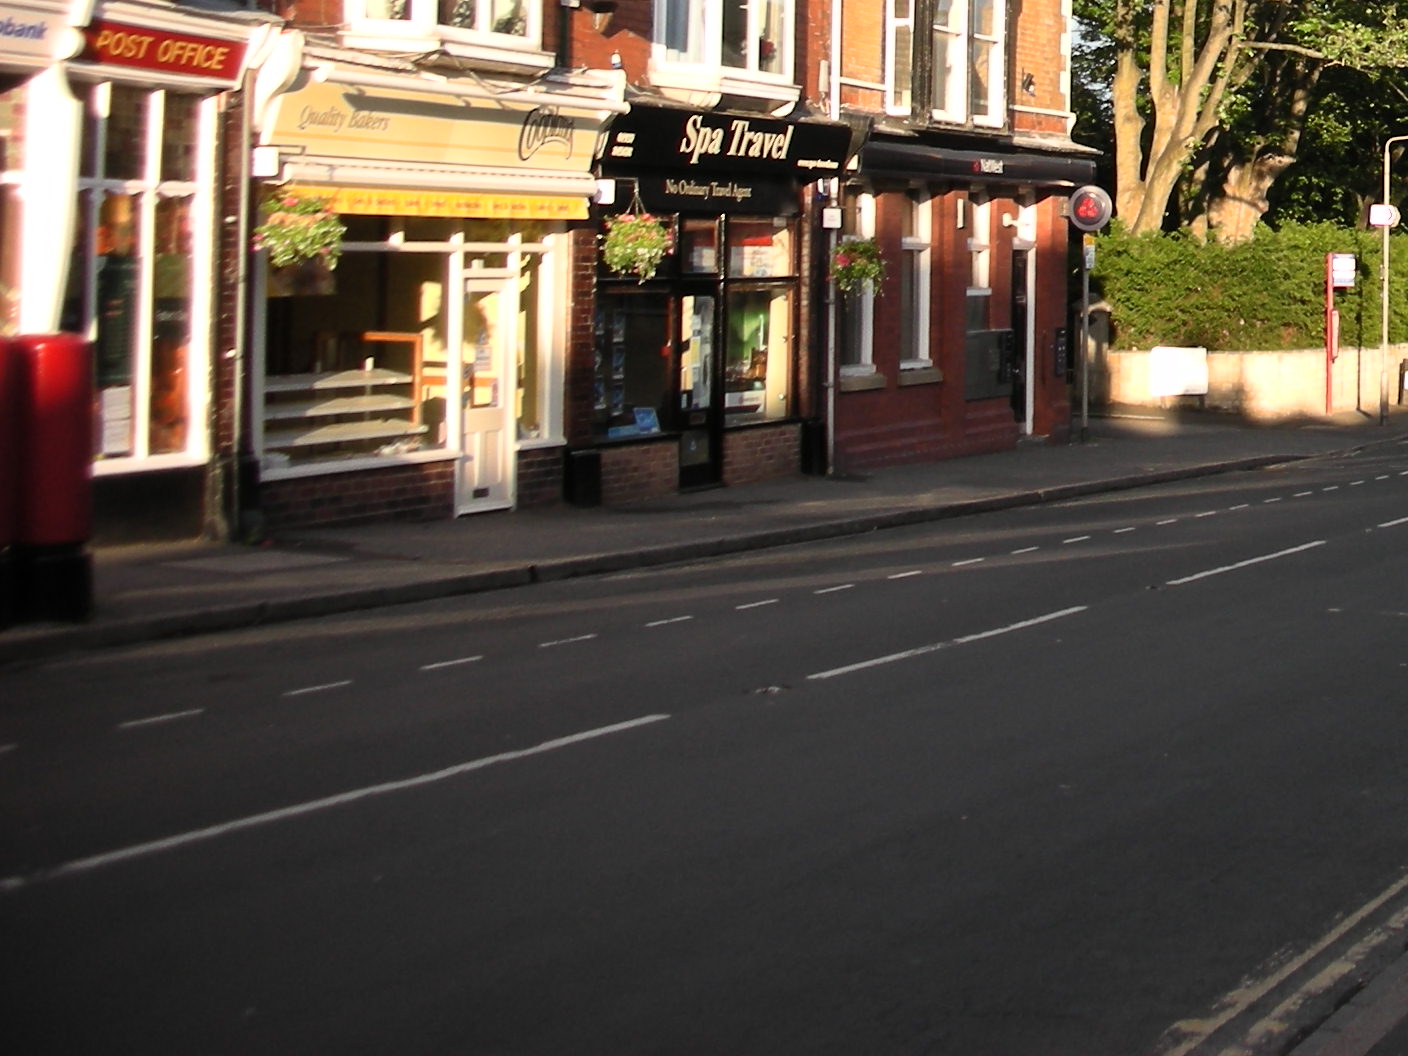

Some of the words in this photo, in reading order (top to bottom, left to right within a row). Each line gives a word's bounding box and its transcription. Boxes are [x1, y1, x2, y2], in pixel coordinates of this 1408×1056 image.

[96, 30, 154, 59] POST
[158, 39, 231, 70] OFFICE
[297, 105, 347, 133] Quality
[347, 111, 391, 131] Bakers
[680, 115, 724, 165] Spa
[727, 119, 795, 160] Travel
[665, 178, 679, 194] No
[679, 179, 710, 200] Ordinary
[710, 181, 732, 198] Travel
[731, 183, 752, 202] Agent
